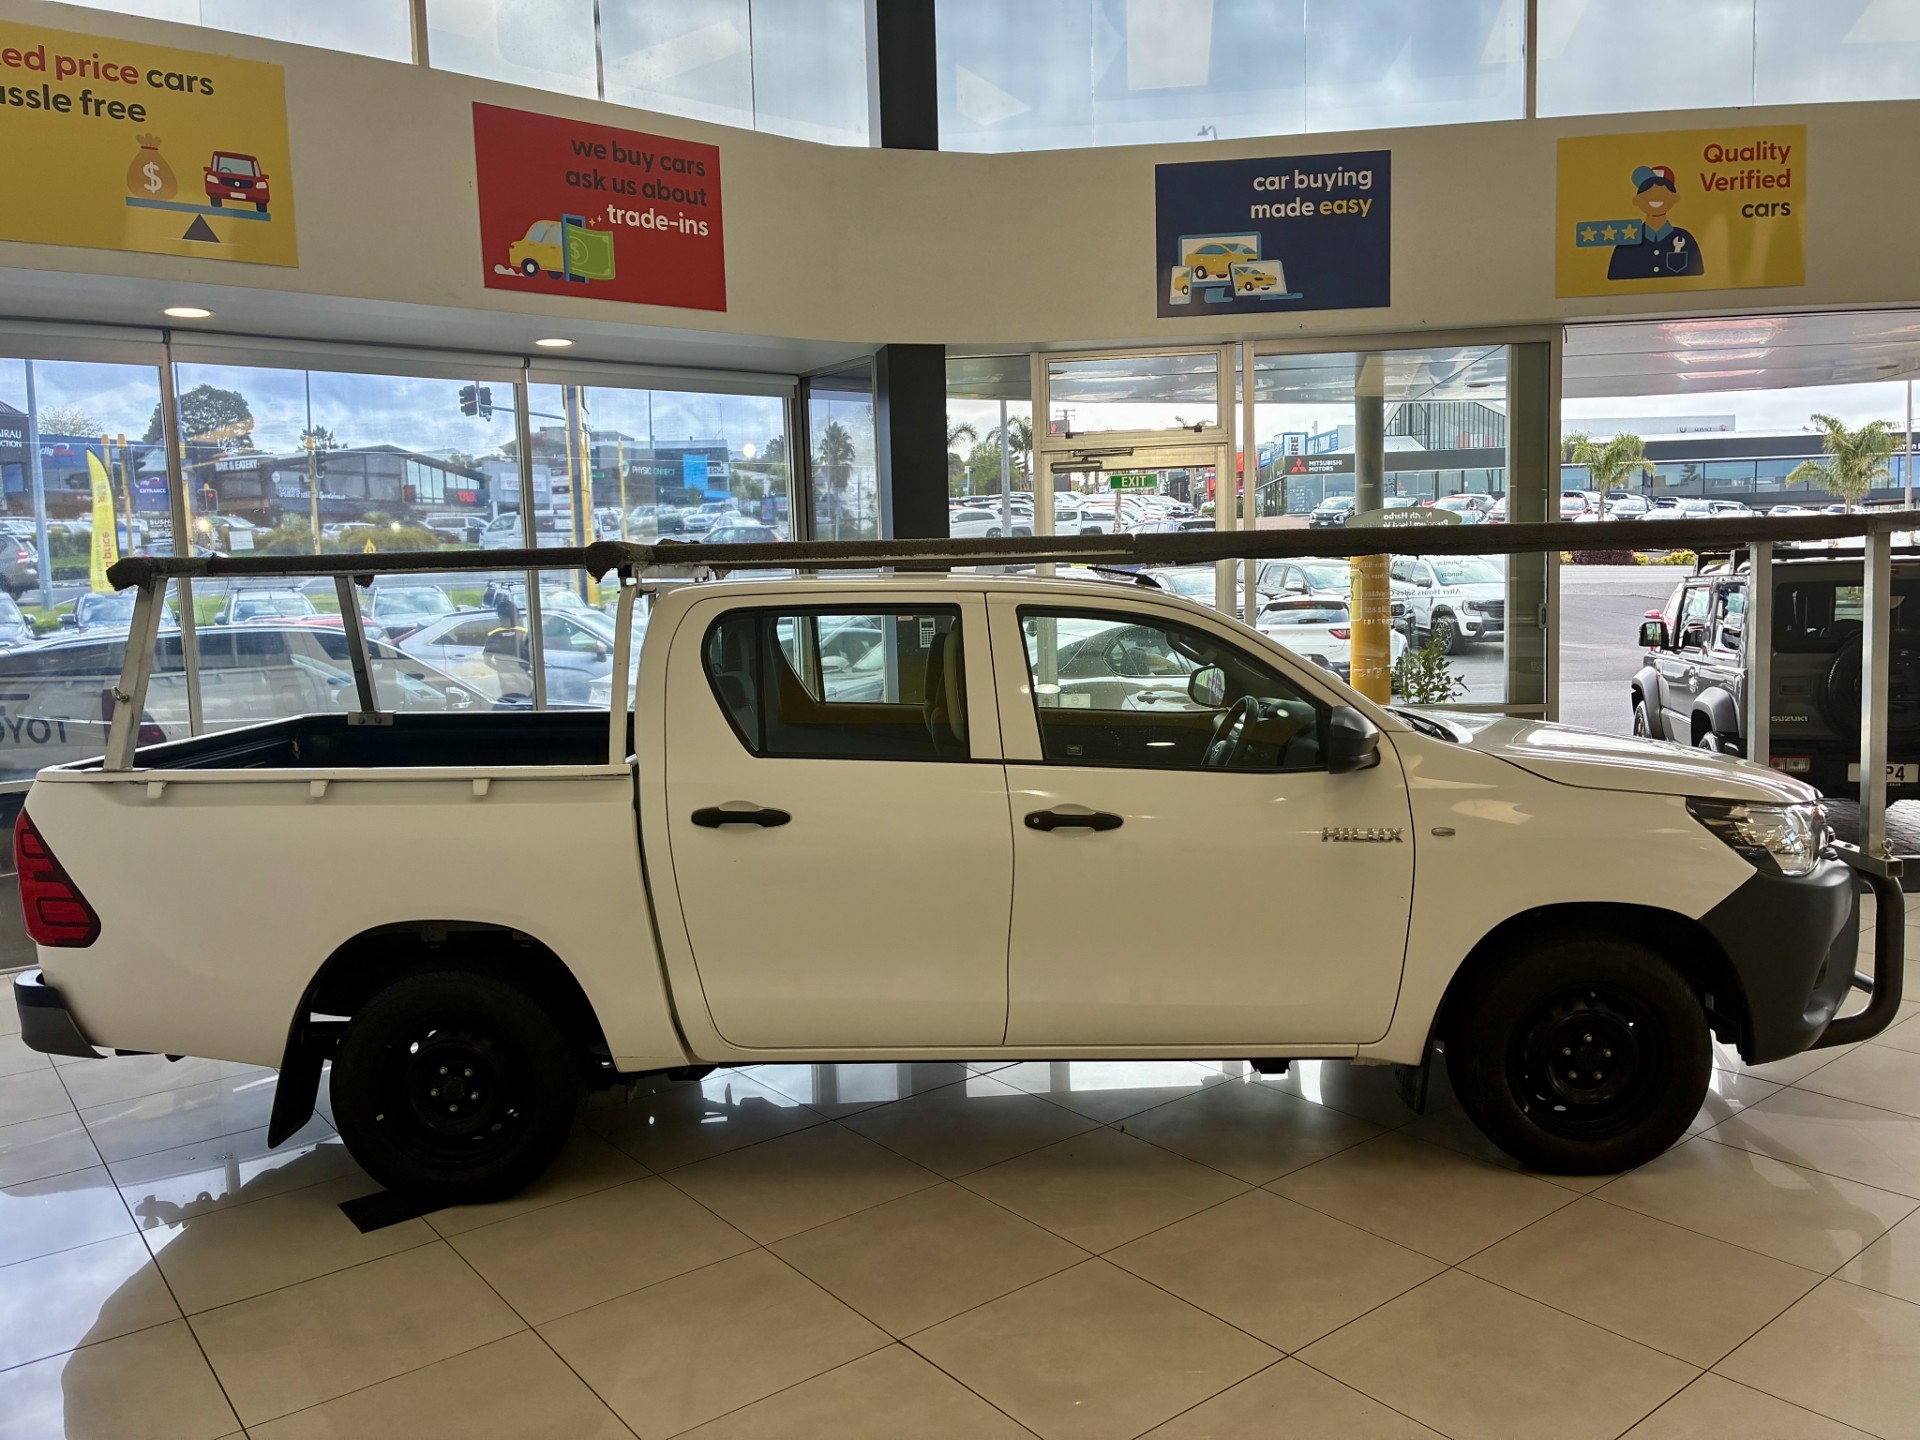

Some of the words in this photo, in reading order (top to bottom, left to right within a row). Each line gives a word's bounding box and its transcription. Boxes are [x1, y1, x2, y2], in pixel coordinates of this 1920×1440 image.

[0, 45, 46, 72] ed
[55, 53, 139, 84] price
[146, 68, 215, 96] cars
[79, 89, 147, 122] free
[571, 138, 607, 160] we
[612, 140, 655, 173] buy
[660, 155, 706, 177] cars
[1703, 141, 1791, 164] Quality
[565, 168, 606, 192] ask
[612, 176, 637, 196] us
[642, 179, 707, 207] about
[1253, 174, 1289, 191] car
[1294, 166, 1372, 191] buying
[1700, 169, 1791, 192] Verified
[1250, 197, 1314, 219] made
[1319, 198, 1372, 217] easy
[1741, 201, 1791, 218] cars
[607, 204, 709, 236] trade-ins
[1309, 459, 1343, 467] MITSUBISHI
[1121, 475, 1147, 488] EXIT
[1320, 827, 1405, 843] HILUX
